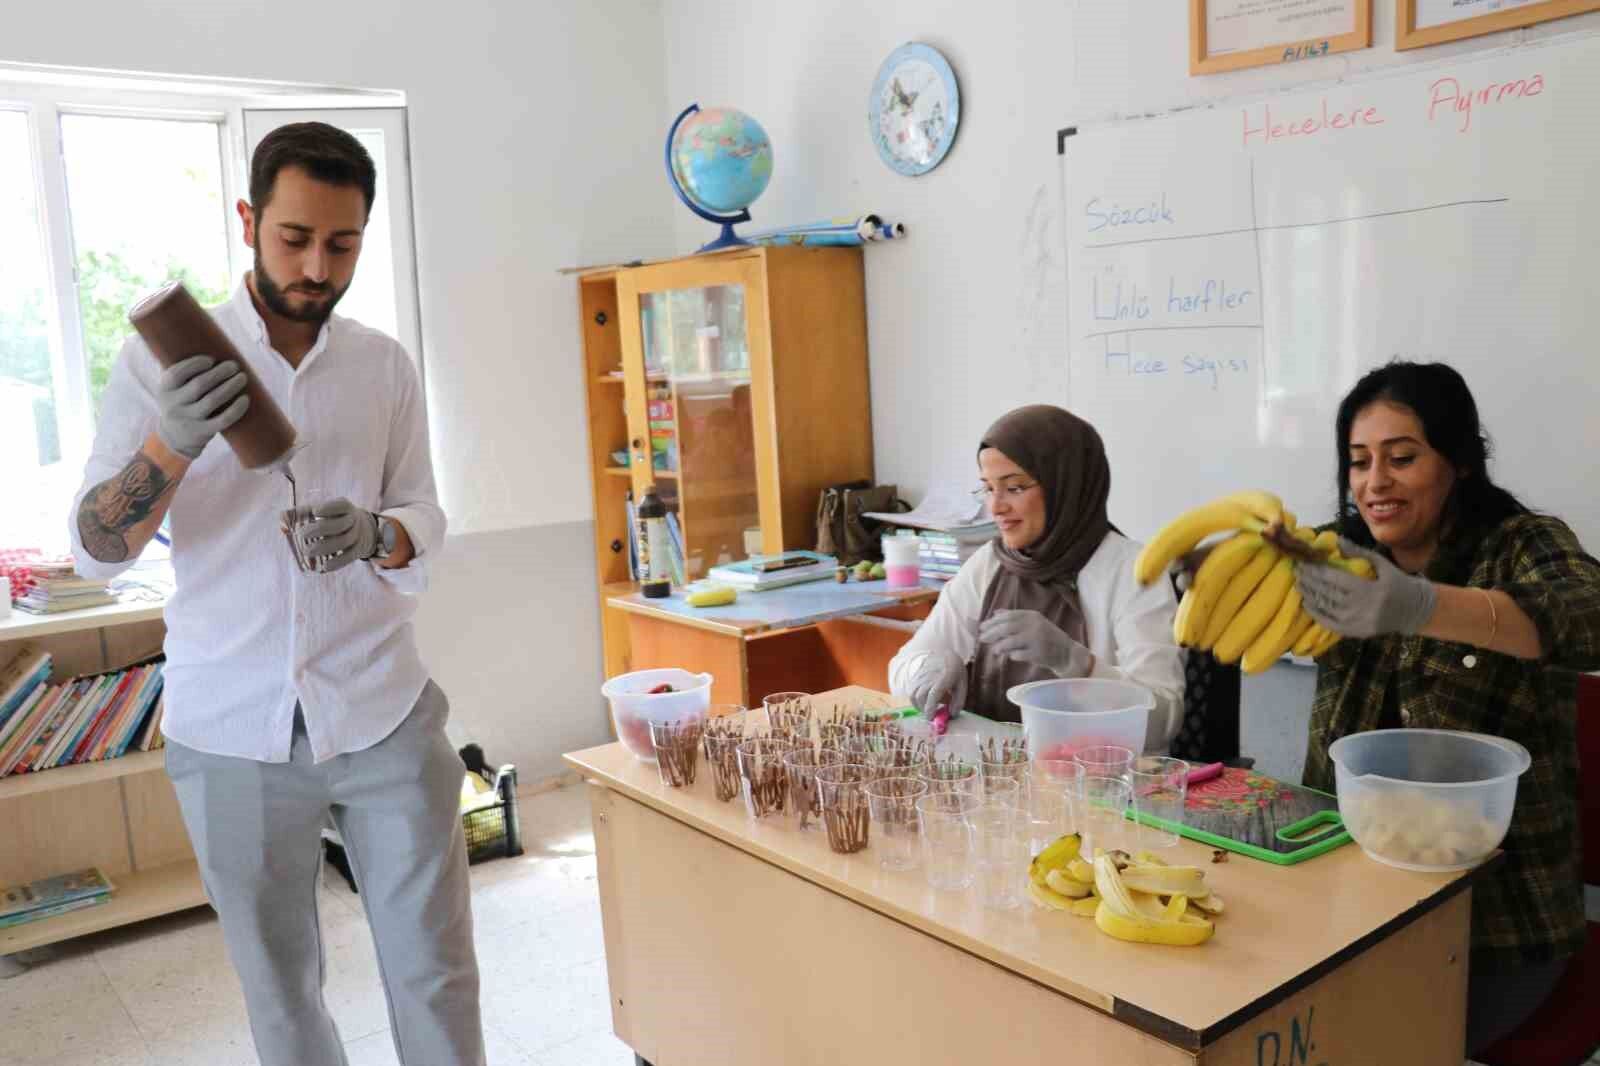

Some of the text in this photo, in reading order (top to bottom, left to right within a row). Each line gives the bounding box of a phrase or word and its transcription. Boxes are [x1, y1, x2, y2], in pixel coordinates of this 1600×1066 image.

[1242, 99, 1385, 144] Hecelere
[1167, 275, 1254, 313] harfler
[1104, 335, 1168, 376] Hece
